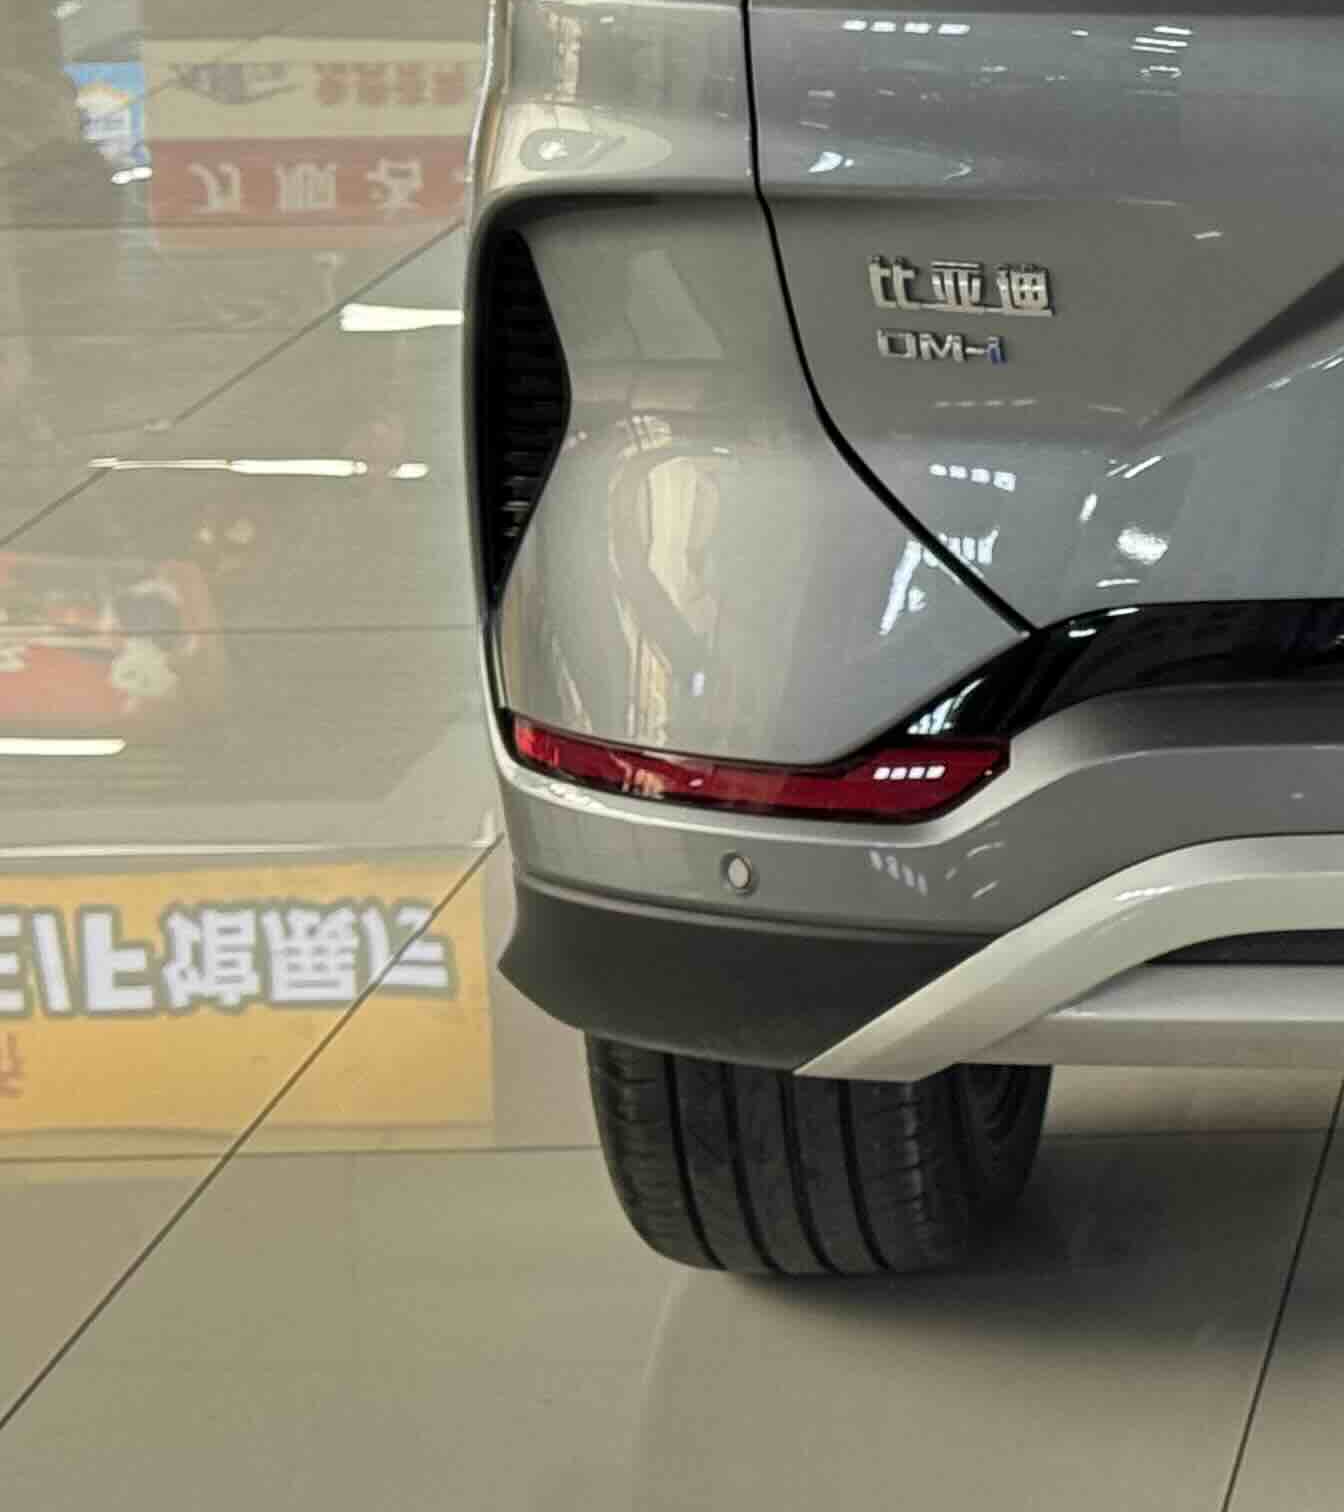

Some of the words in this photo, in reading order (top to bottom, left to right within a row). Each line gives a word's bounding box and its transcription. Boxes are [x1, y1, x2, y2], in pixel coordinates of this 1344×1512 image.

[867, 255, 1054, 316] 比亚迪
[876, 329, 1008, 364] DM-i
